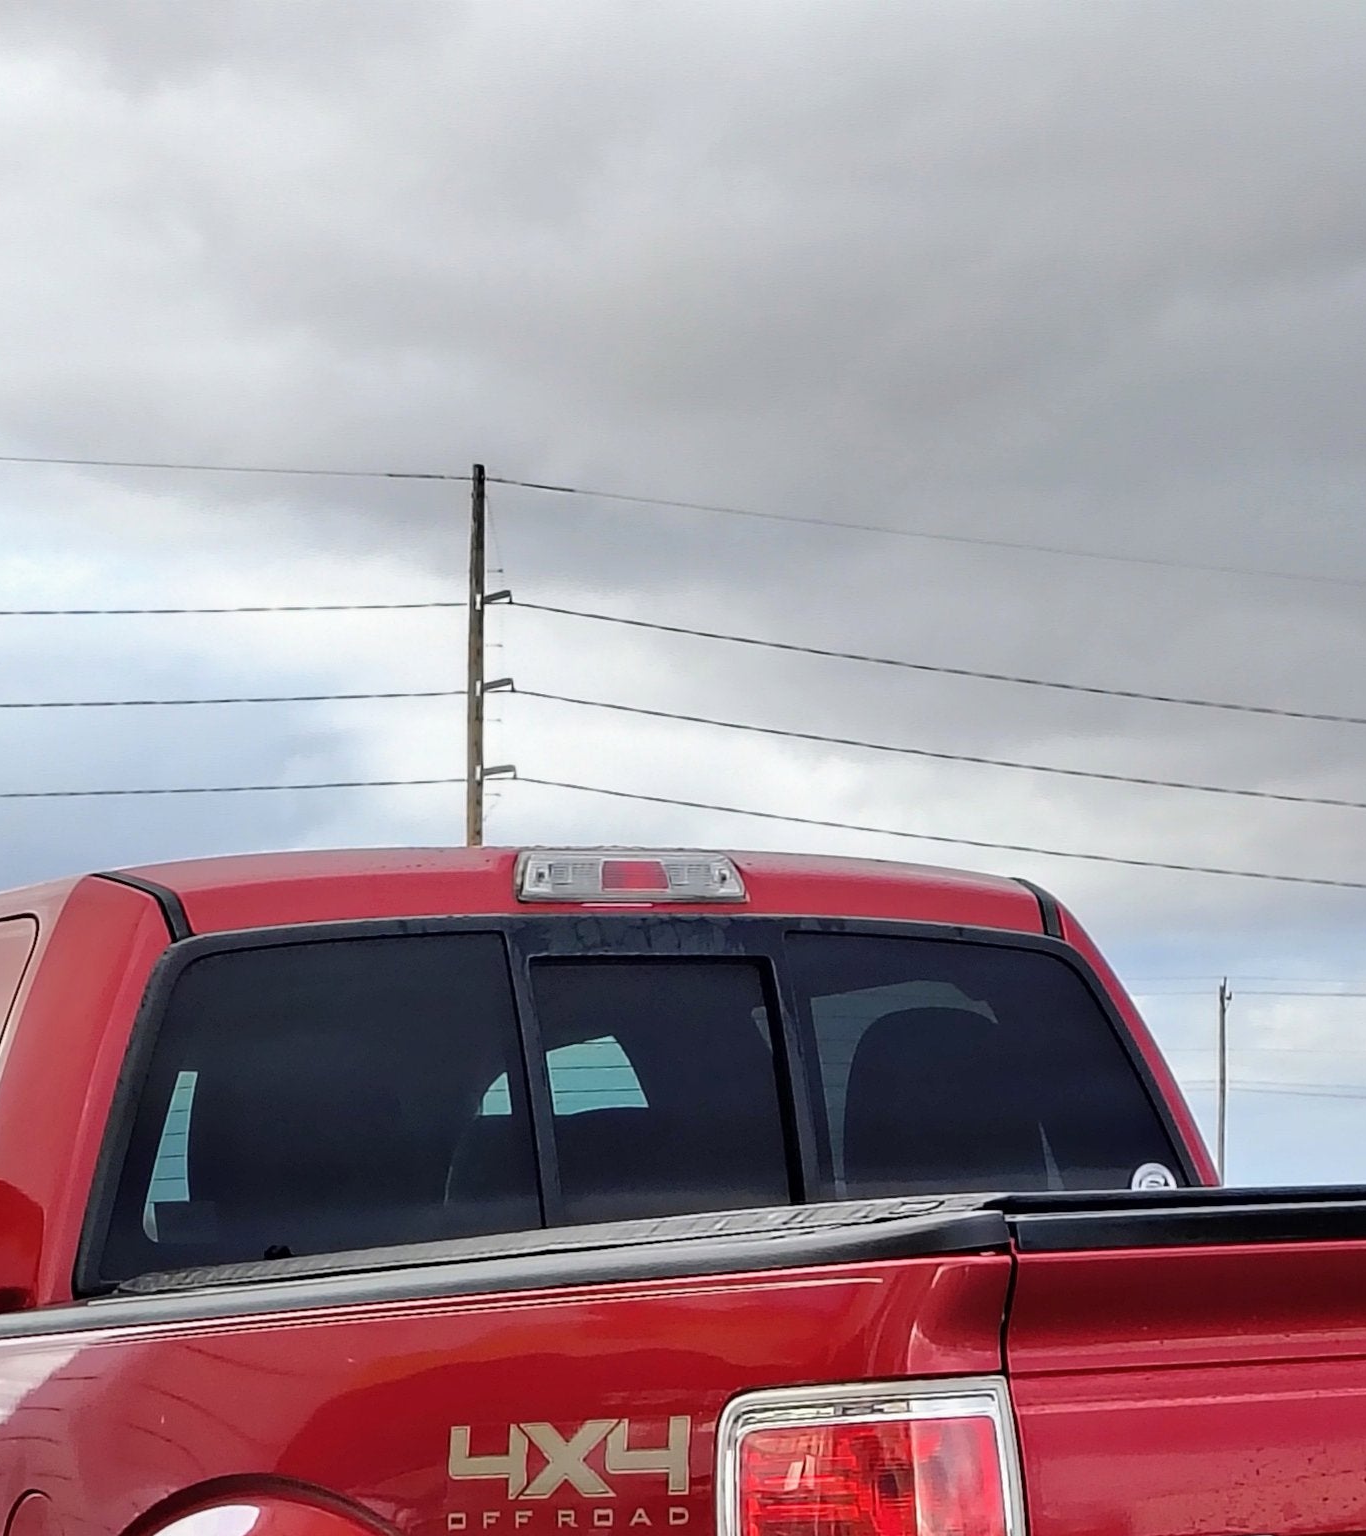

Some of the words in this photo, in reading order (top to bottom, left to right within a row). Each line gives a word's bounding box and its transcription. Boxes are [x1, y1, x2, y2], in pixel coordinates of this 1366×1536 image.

[448, 1415, 691, 1500] 4X4
[447, 1509, 534, 1531] OFF
[557, 1506, 690, 1529] ROAD
